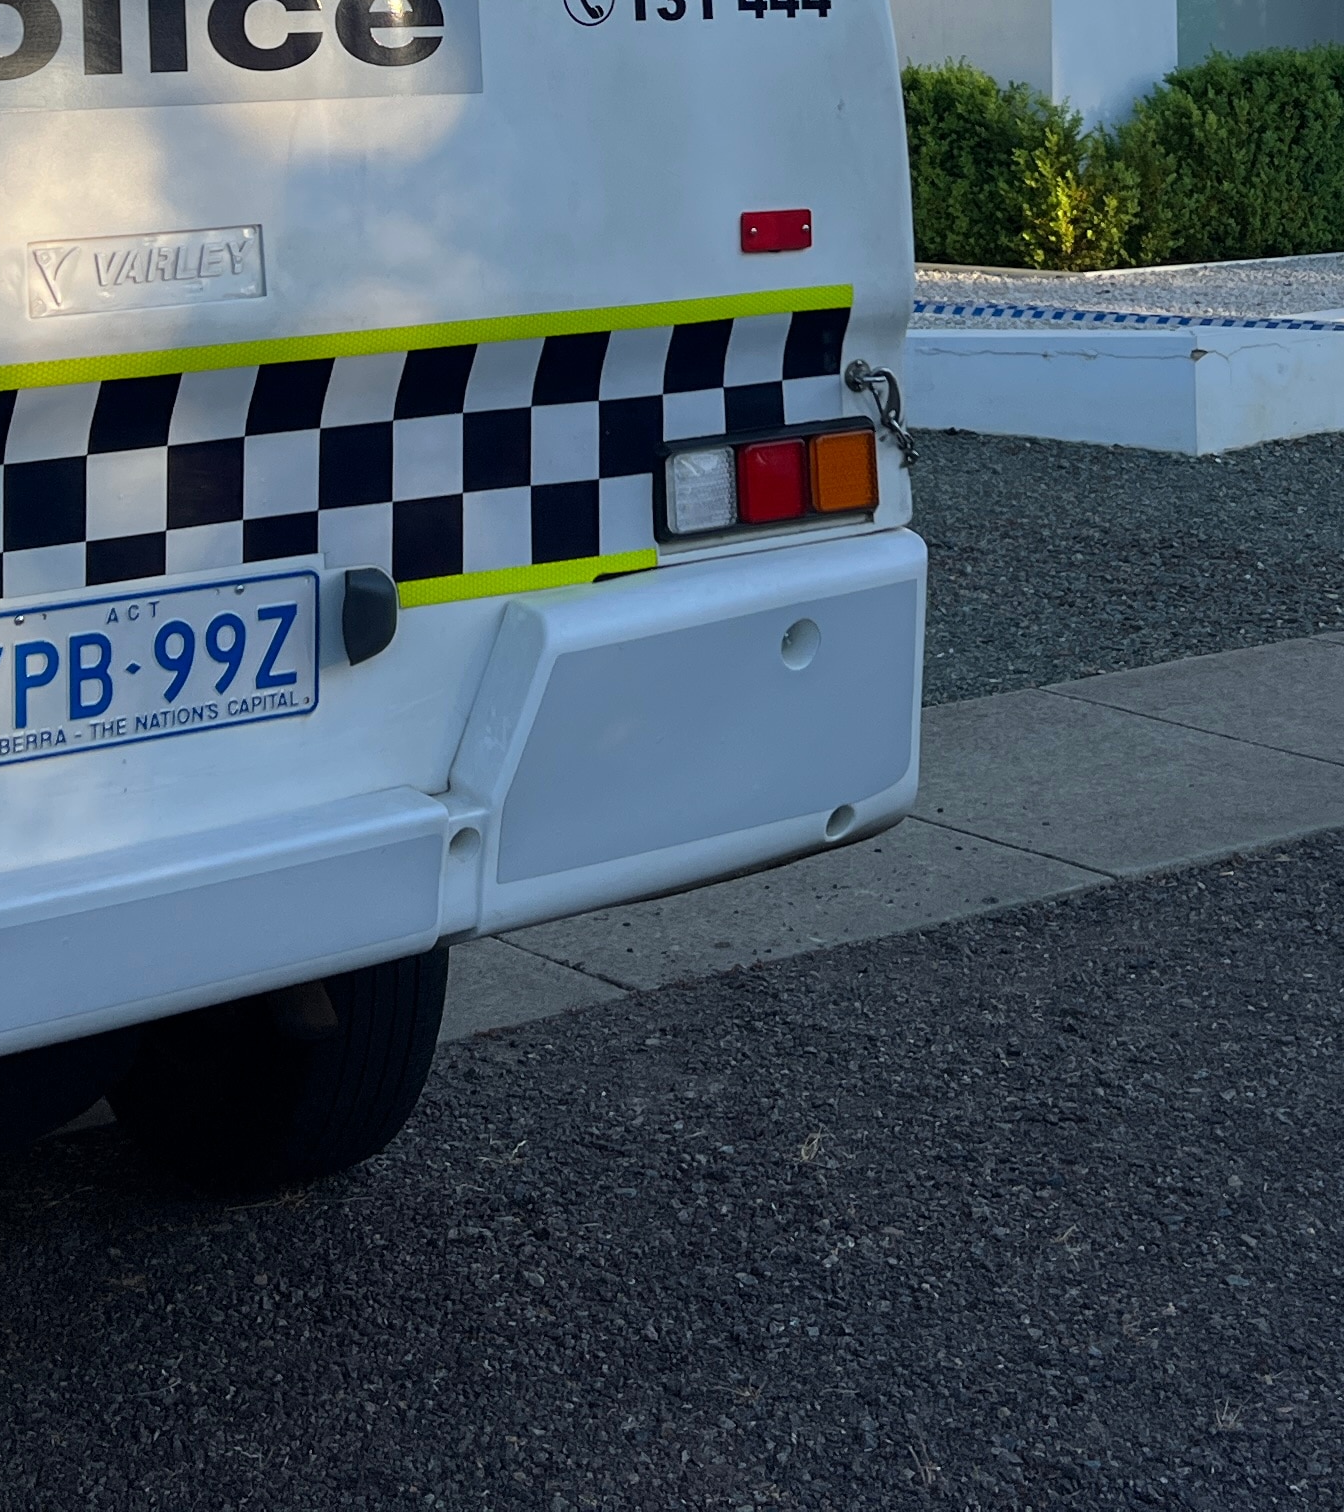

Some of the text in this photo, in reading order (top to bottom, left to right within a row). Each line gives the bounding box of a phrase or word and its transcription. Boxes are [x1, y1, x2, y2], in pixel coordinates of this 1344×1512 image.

[94, 240, 254, 287] VARLEY
[106, 600, 160, 625] ACT
[90, 717, 127, 739] THE
[227, 690, 299, 716] CAPITAL
